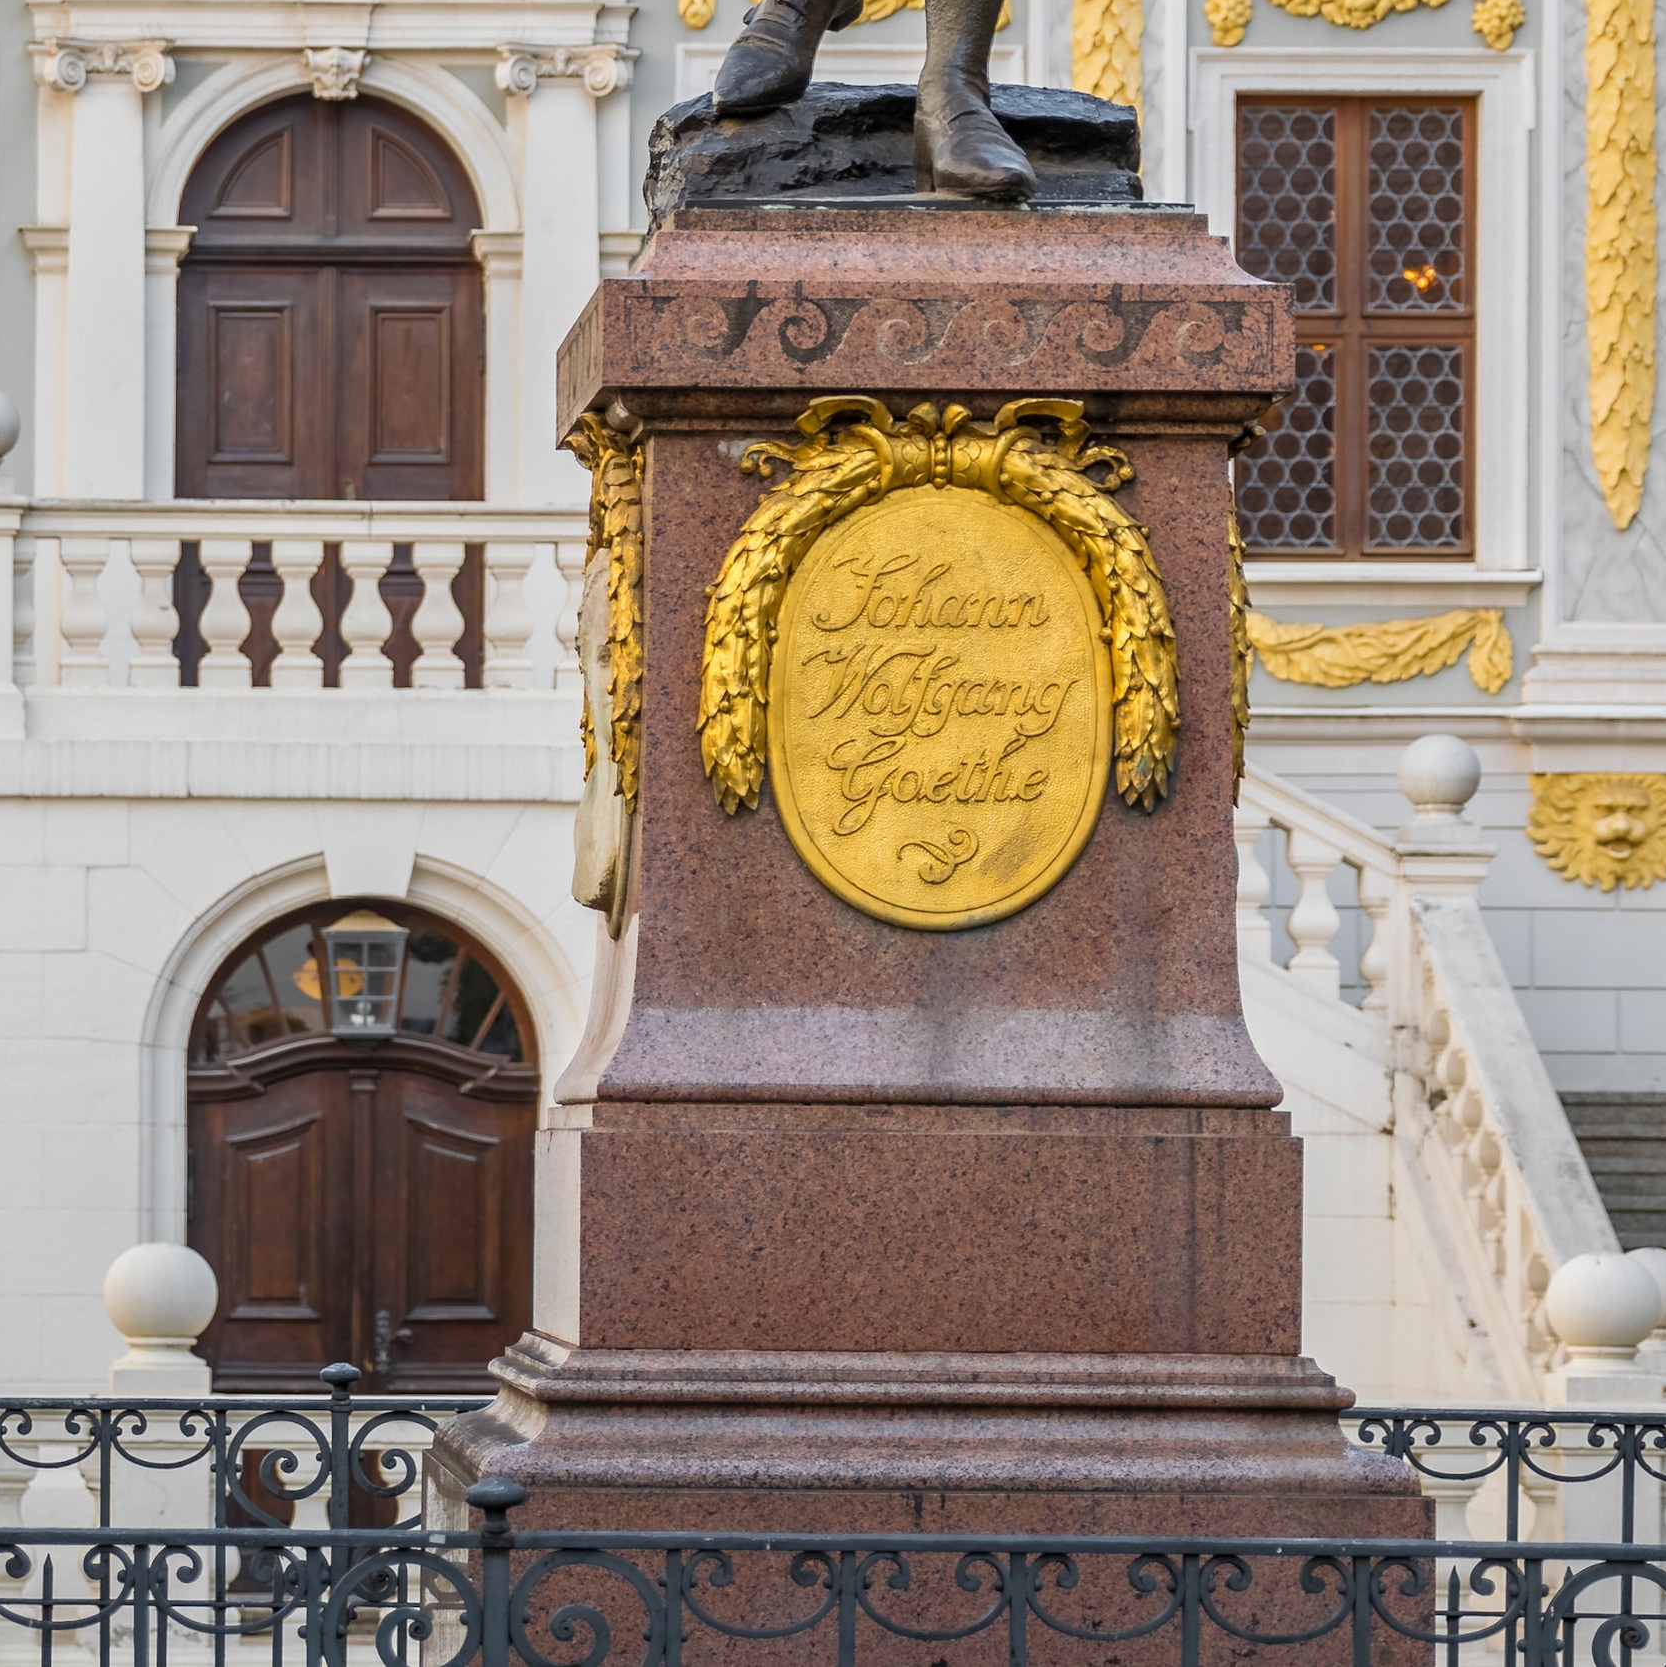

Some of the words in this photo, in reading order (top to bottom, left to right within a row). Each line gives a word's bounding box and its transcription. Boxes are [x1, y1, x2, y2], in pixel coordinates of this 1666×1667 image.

[811, 553, 1050, 631] Johann
[802, 644, 1080, 737] Wolfgang
[826, 736, 1050, 835] Goethe
